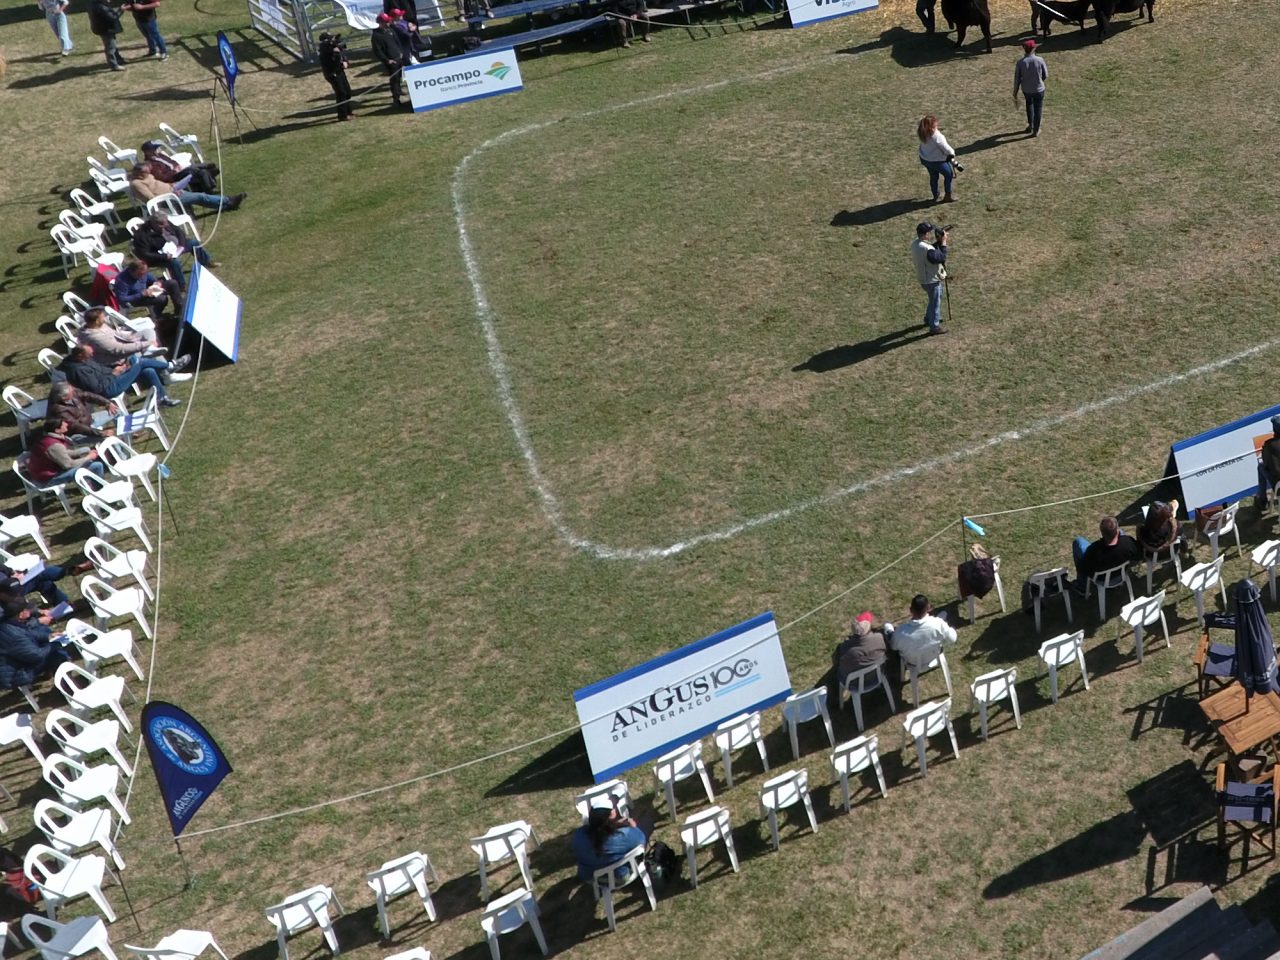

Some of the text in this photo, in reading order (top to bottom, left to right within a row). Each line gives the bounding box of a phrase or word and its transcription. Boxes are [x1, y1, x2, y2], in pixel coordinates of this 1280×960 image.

[414, 69, 481, 90] Procampo
[610, 673, 710, 733] ANGUS
[612, 695, 712, 742] DE LIDERAZGO
